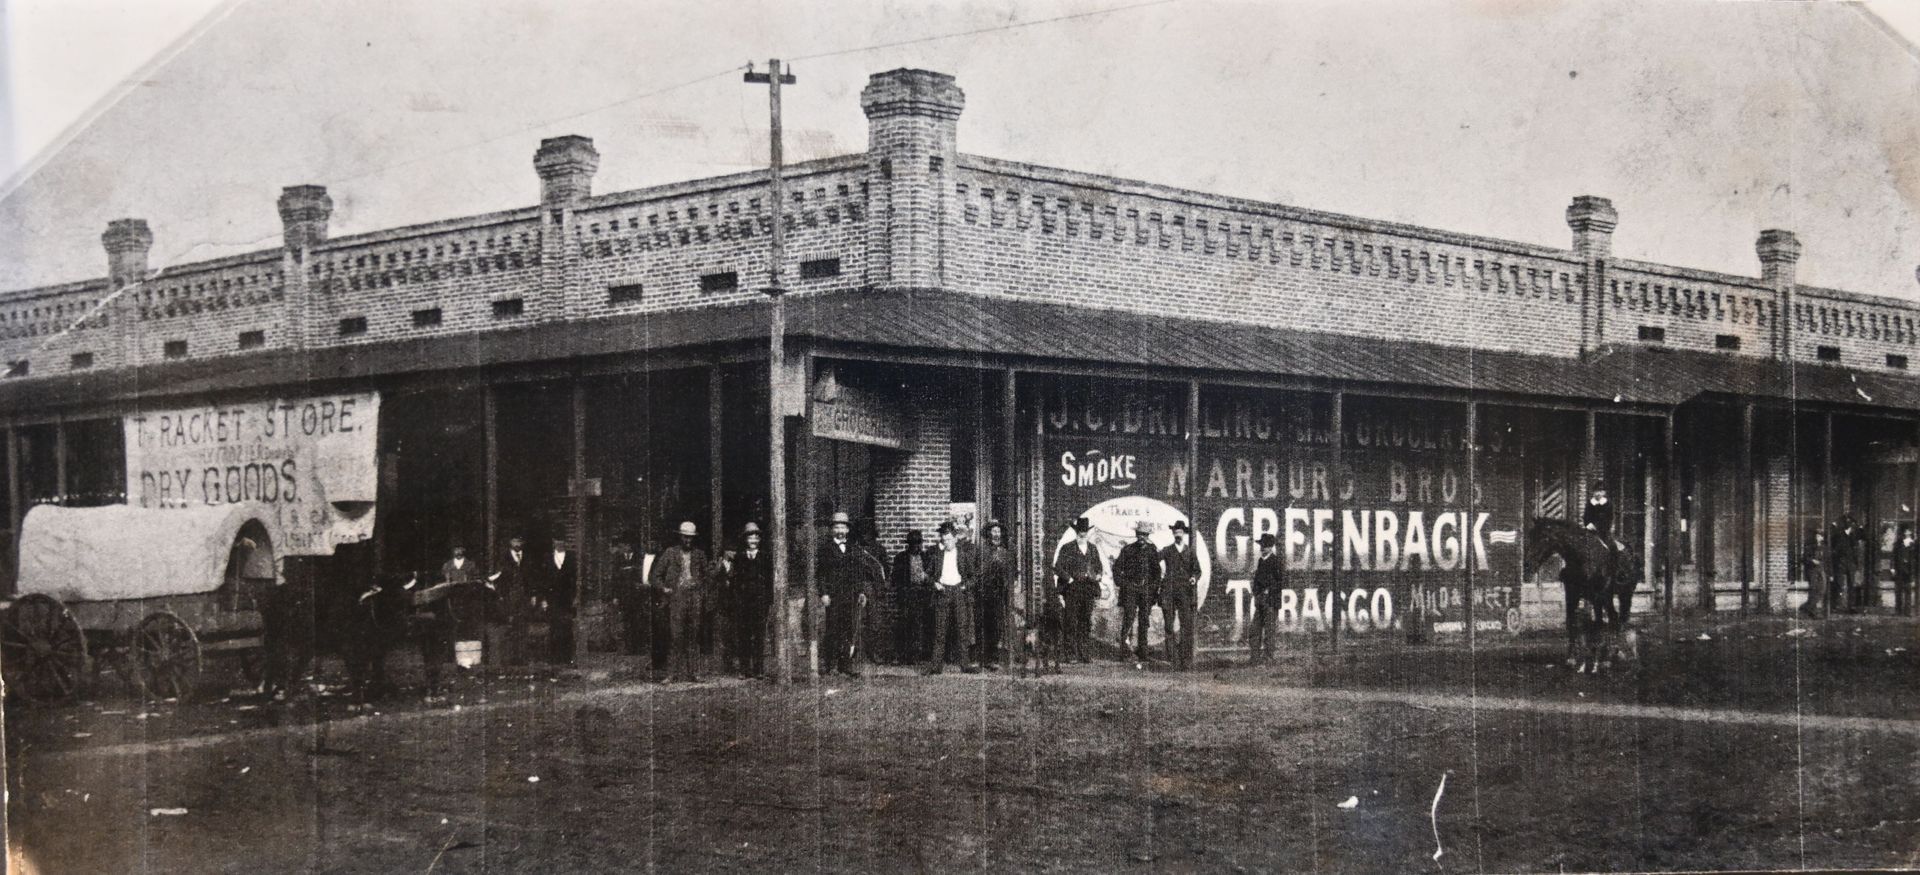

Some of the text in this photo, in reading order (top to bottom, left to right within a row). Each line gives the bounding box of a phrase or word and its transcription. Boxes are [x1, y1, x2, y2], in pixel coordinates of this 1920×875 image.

[160, 409, 245, 448] RACKET
[264, 399, 363, 438] STORE.
[140, 467, 192, 509] DRY
[1061, 451, 1137, 488] SMOKE
[1215, 507, 1490, 573] GREENBACK
